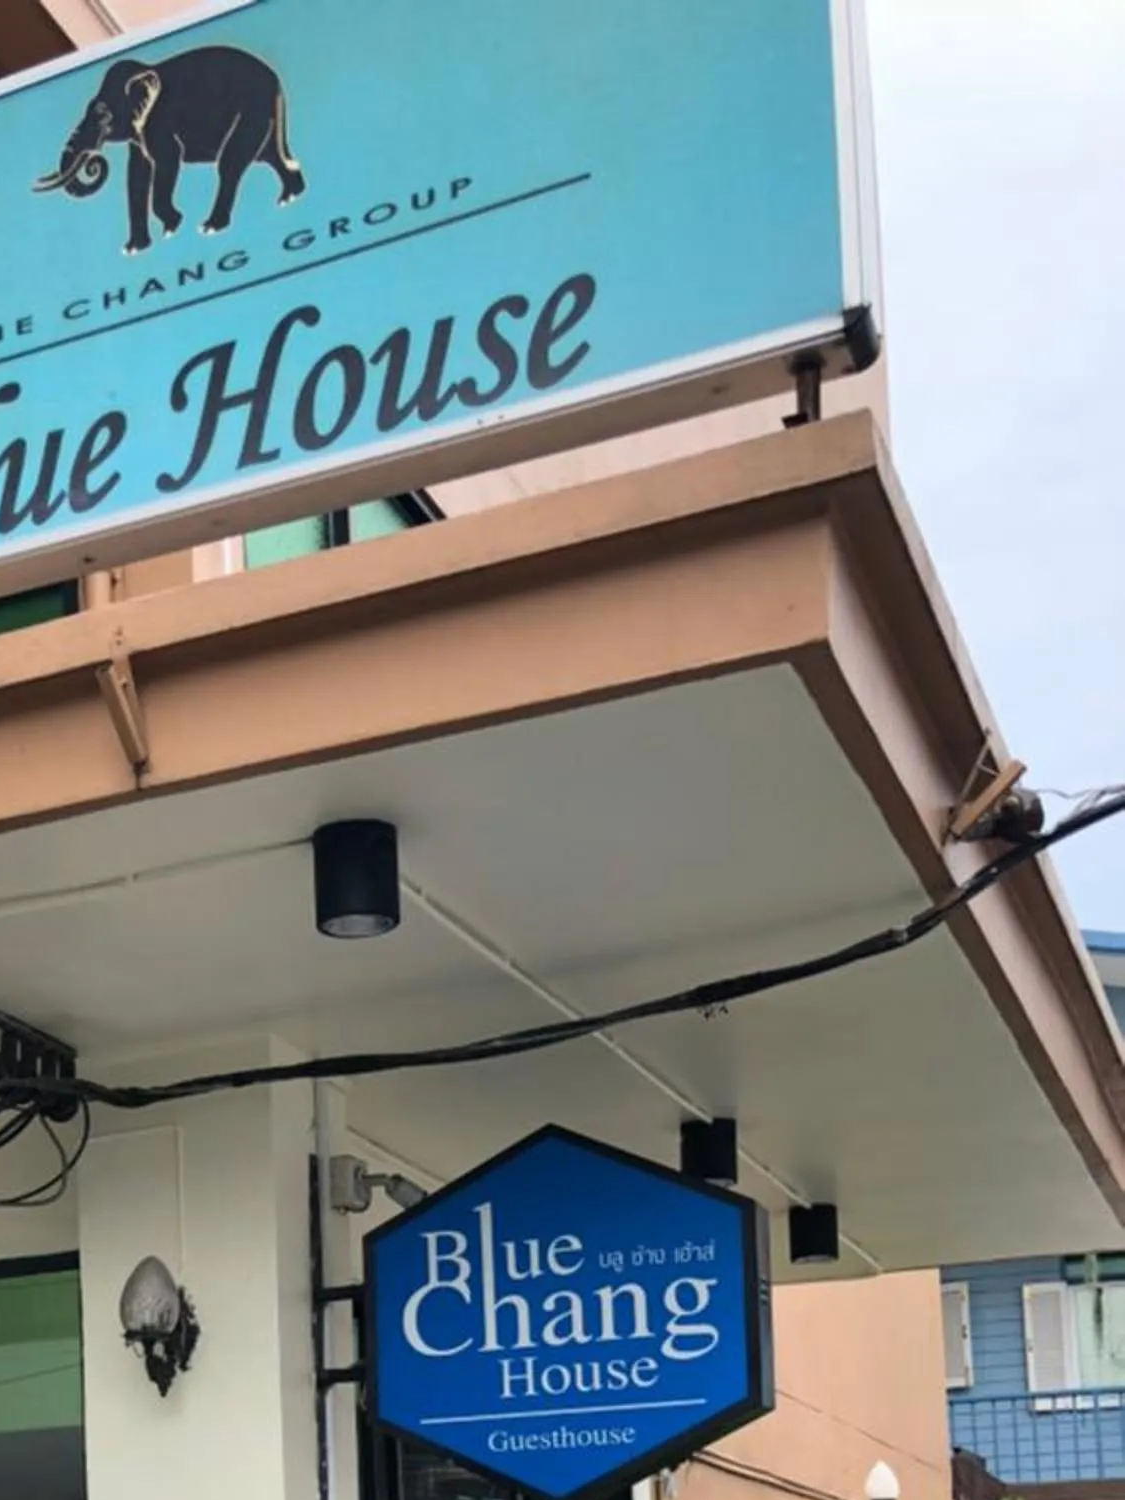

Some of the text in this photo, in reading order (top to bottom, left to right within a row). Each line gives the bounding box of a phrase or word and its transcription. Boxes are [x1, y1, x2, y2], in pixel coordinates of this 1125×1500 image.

[61, 249, 251, 321] CHANG
[282, 176, 473, 251] GROUP
[155, 272, 597, 494] House
[420, 1201, 584, 1288] Blue
[401, 1270, 720, 1361] Chang
[498, 1355, 660, 1400] House
[487, 1423, 636, 1454] Guesthouse
